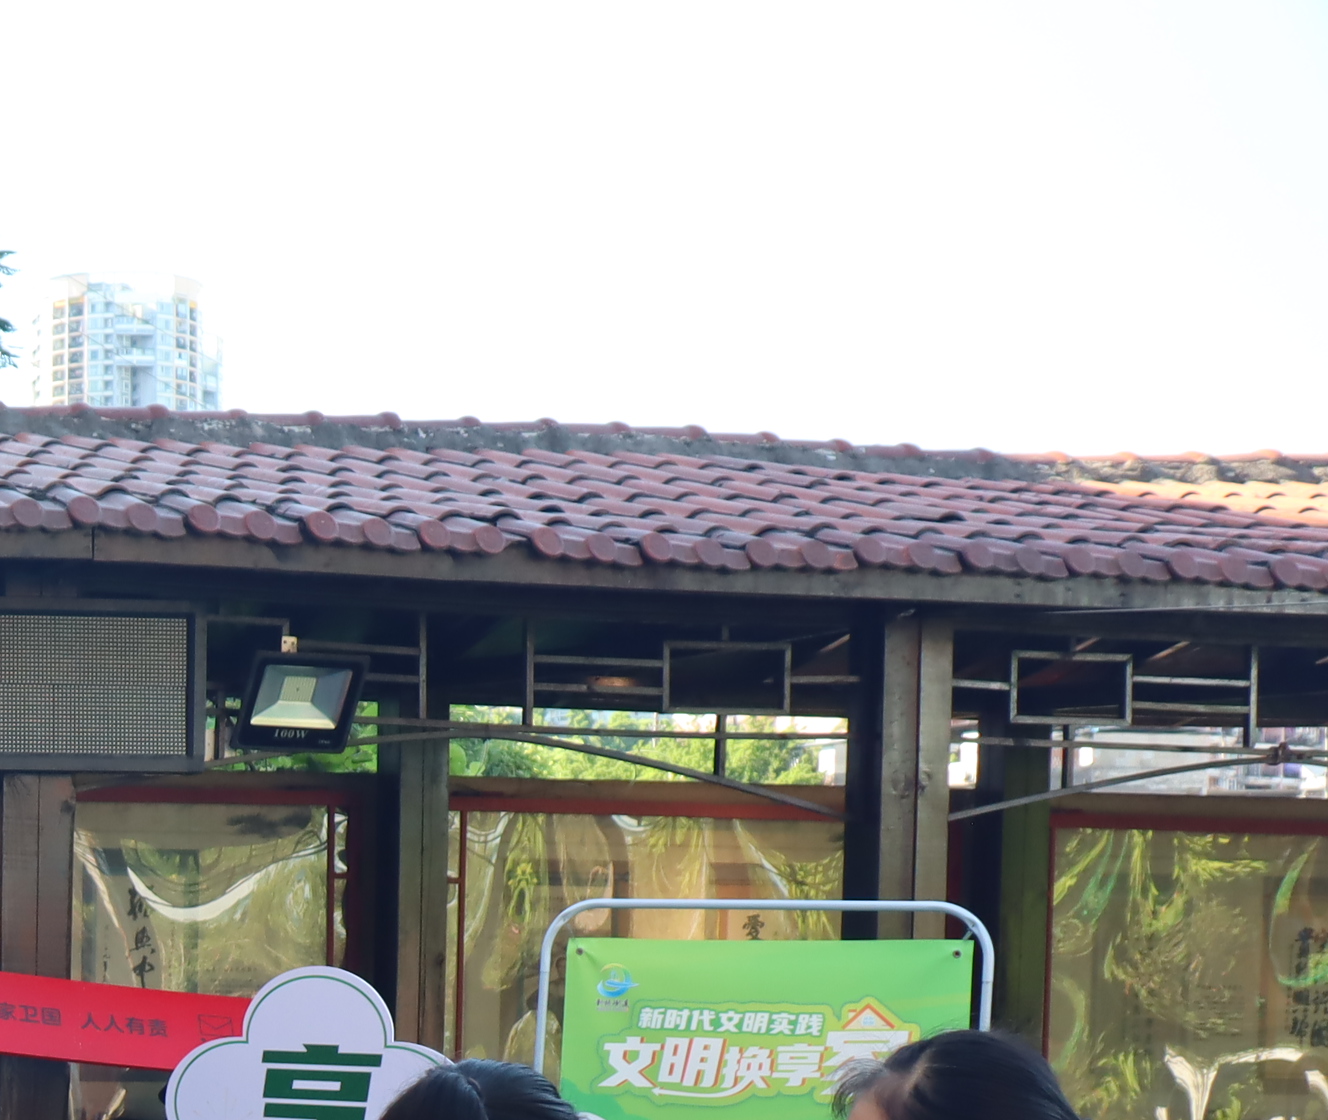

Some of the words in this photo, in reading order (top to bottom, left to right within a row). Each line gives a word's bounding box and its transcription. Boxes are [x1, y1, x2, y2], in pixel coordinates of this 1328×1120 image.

[81, 1011, 170, 1038] 人人有责
[637, 1006, 825, 1037] 新时代文明实践
